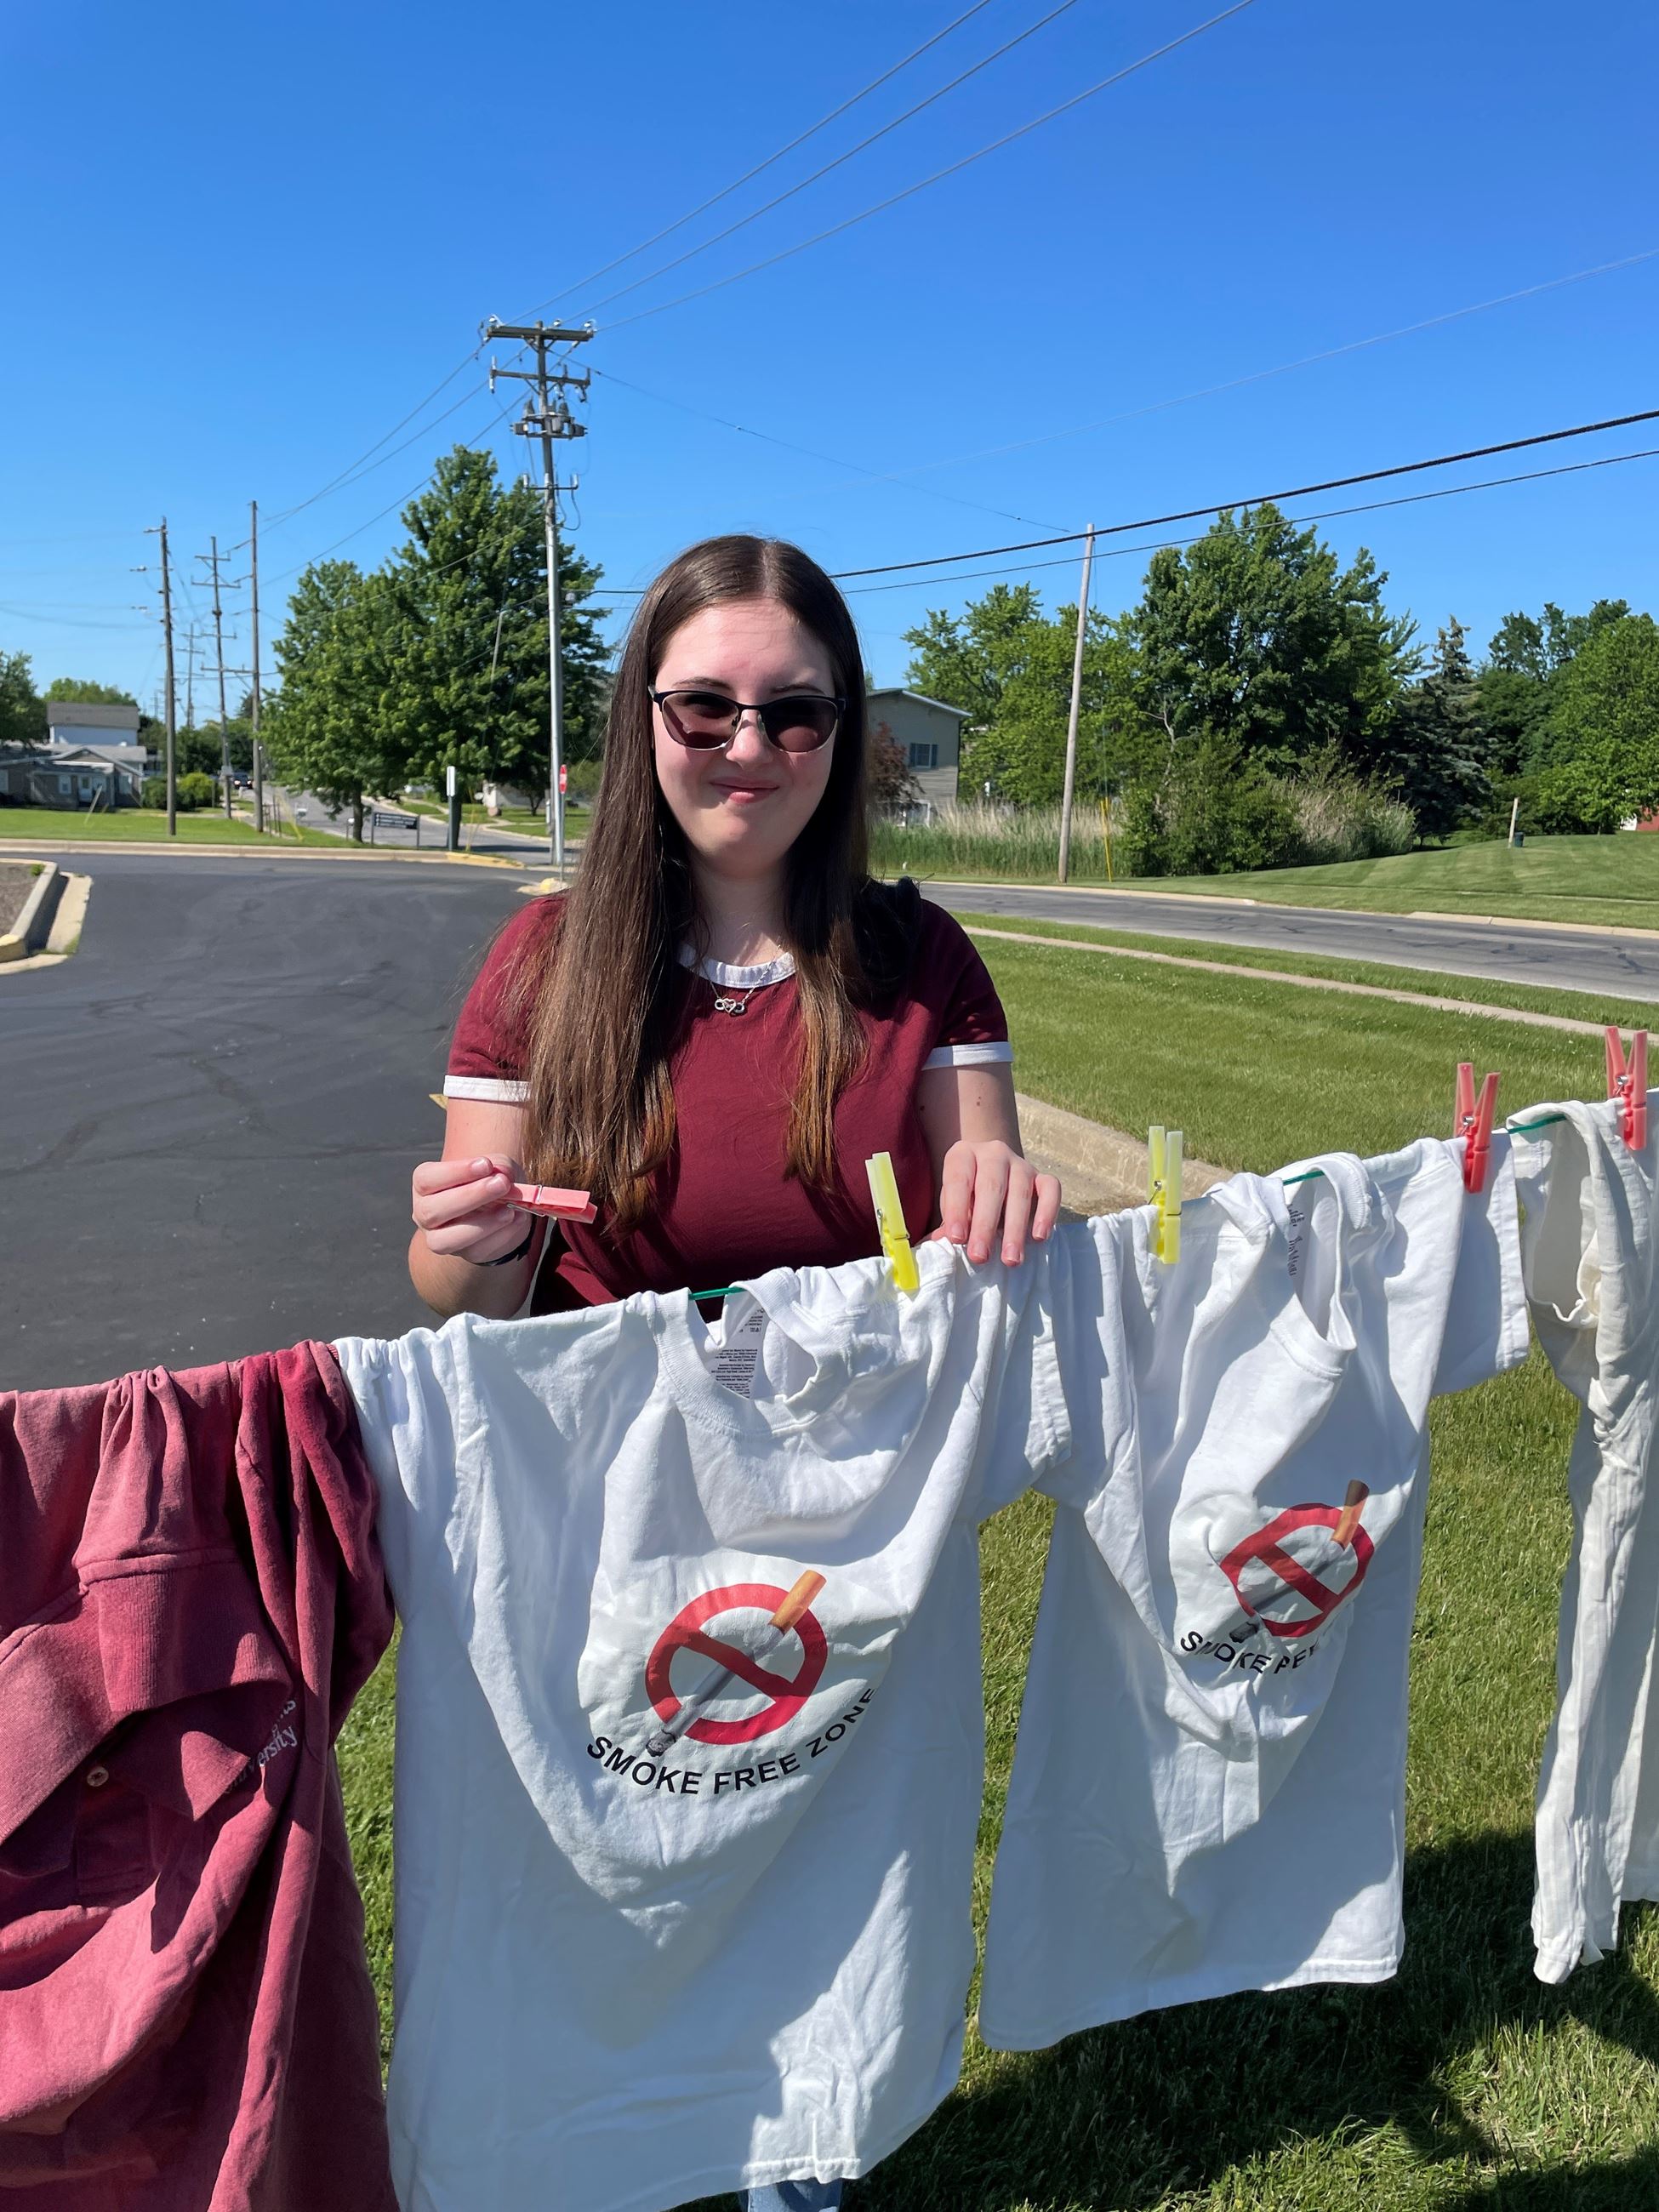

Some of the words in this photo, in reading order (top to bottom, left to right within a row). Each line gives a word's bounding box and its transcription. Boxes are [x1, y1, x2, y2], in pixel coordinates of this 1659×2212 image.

[587, 1736, 703, 1795] SMOKE
[714, 1752, 801, 1795] FREE
[805, 1687, 877, 1759] ZONE
